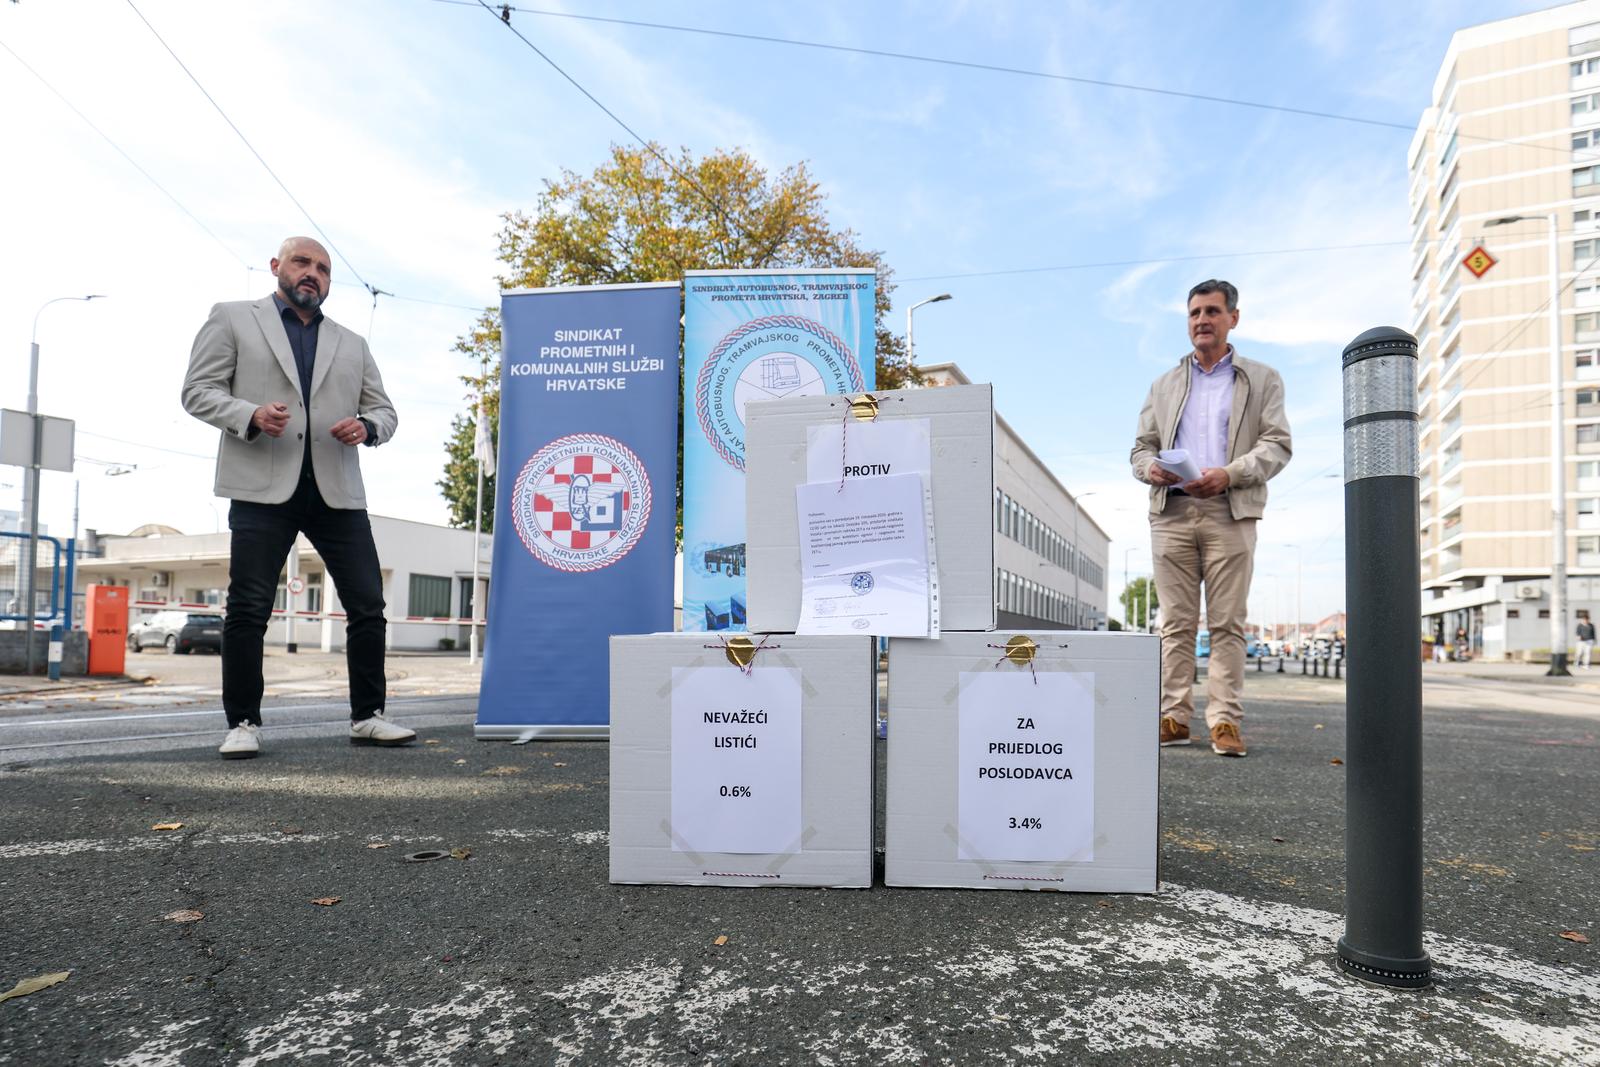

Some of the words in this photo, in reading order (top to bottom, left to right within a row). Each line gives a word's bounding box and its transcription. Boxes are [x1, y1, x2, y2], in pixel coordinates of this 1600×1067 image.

[1475, 256, 1483, 269] 5
[737, 284, 800, 292] AUTOBUSNOG,
[802, 283, 868, 291] TRAMVAJSKOG
[554, 328, 622, 342] SINDIKAT
[540, 344, 626, 358] PROMETNIH
[630, 344, 634, 356] I
[728, 333, 799, 364] TRAMVAJSKOG
[807, 340, 842, 381] PROMETA
[510, 362, 608, 376] KOMUNALNIH
[612, 356, 664, 373] SLUŽBI
[546, 378, 626, 391] HRVATSKE
[530, 446, 584, 486] PROMETNIH
[593, 446, 639, 499] KOMUNALNIH
[844, 464, 891, 476] PROTIV
[524, 488, 540, 539] SINDIKAT
[552, 546, 608, 560] HRVATSKE
[704, 709, 768, 724] NEVAŽEĆI
[1017, 718, 1035, 730] ZA
[714, 734, 756, 748] LISTIĆI
[989, 742, 1063, 754] PRIJEDLOG
[979, 768, 1073, 780] POSLODAVCA
[720, 786, 752, 798] 0.6%
[1008, 817, 1042, 830] 3.4%
